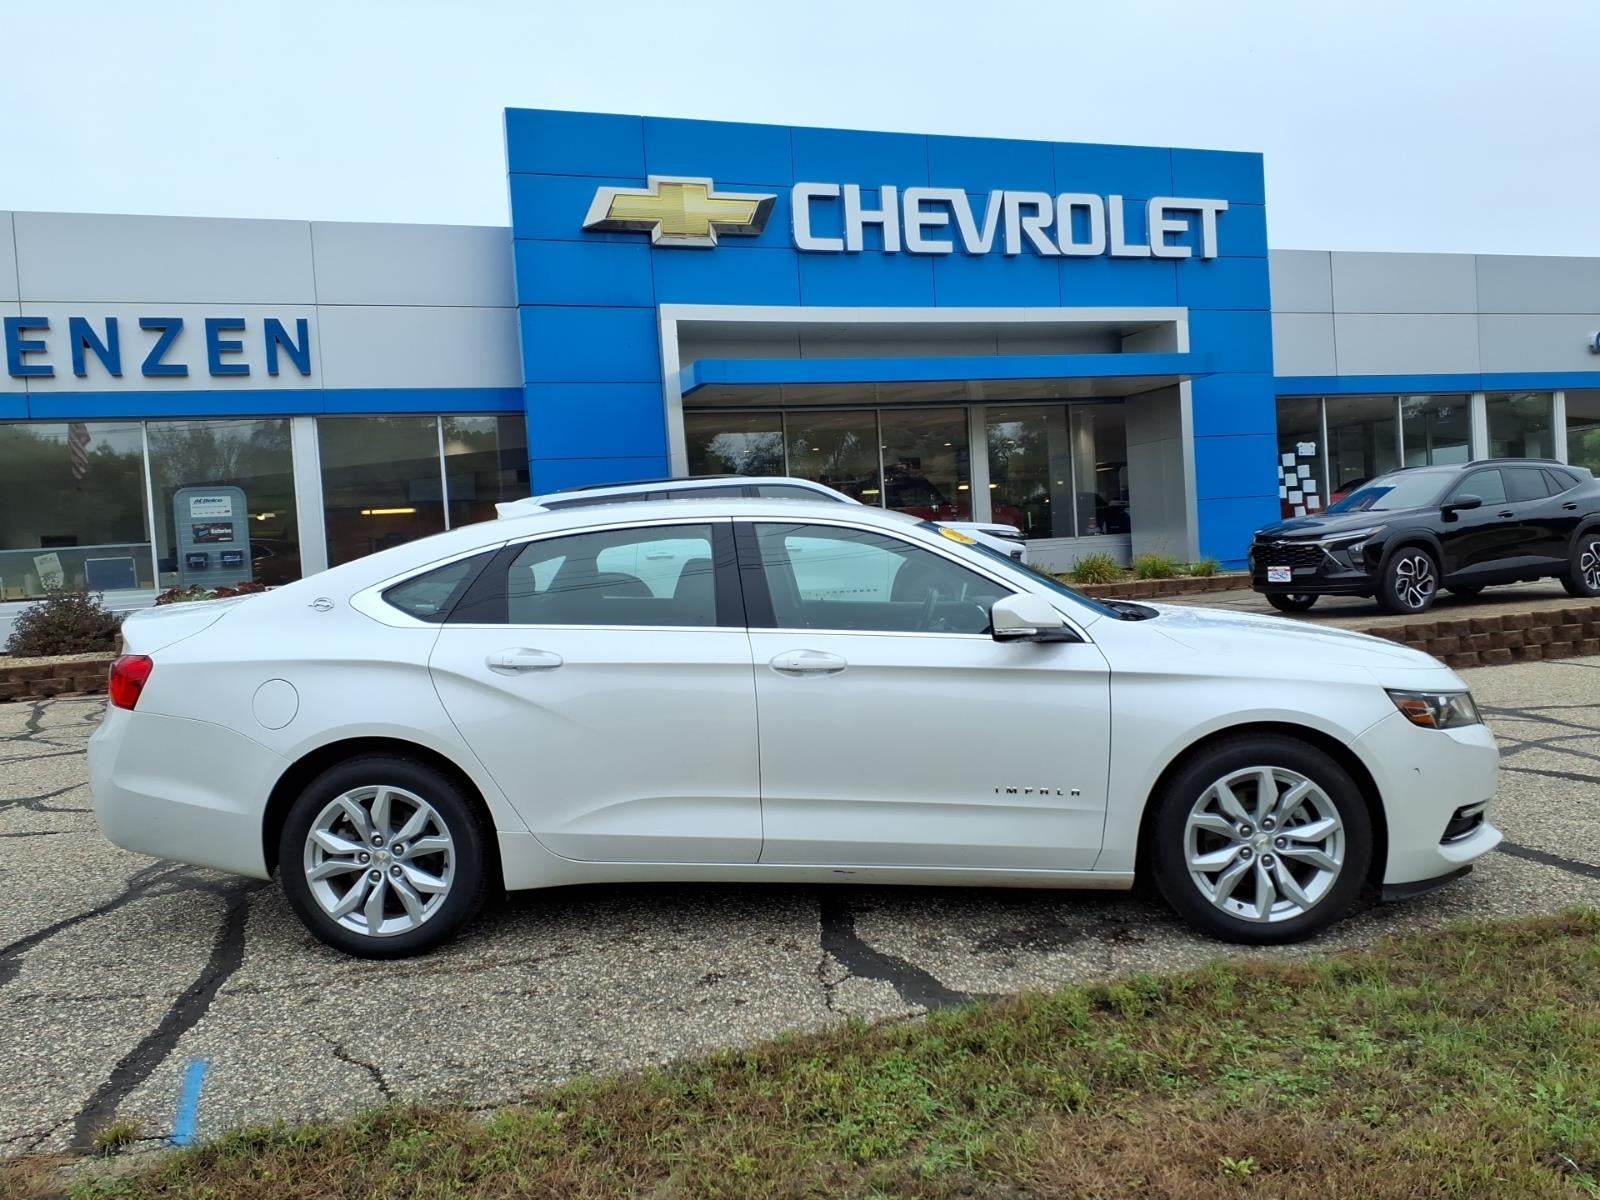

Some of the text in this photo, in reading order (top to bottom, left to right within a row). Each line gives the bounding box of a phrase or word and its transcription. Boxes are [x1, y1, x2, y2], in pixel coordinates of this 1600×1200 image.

[791, 181, 1229, 260] CHEVROLET
[3, 316, 312, 377] ENZEN
[994, 786, 1081, 797] IMPALA
